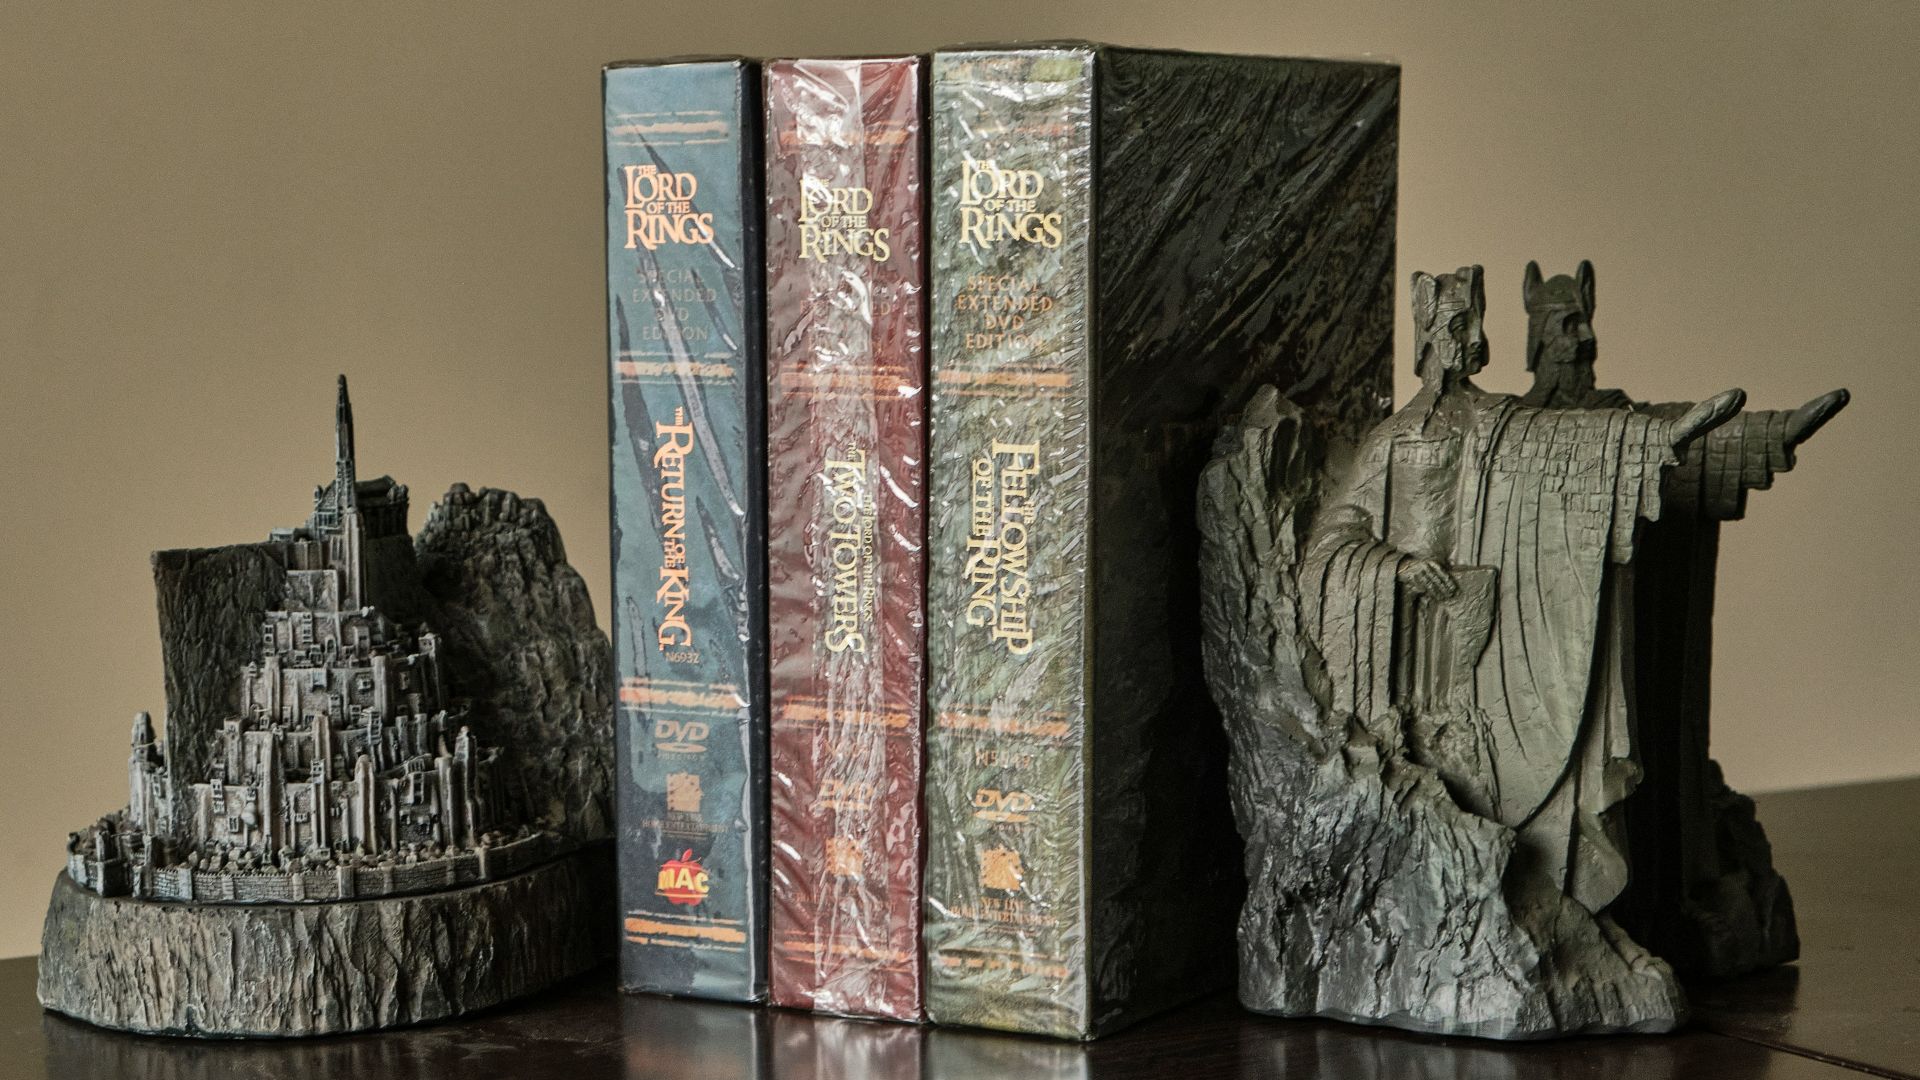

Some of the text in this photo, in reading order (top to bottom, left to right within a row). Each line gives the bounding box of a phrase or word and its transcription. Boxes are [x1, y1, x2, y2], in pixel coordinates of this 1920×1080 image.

[637, 165, 657, 175] THE
[960, 160, 1044, 206] LORD
[624, 165, 697, 209] LORD
[798, 178, 873, 222] LORD
[646, 202, 690, 214] OF THE
[983, 200, 1037, 213] OF THE
[624, 209, 714, 250] RINGS
[821, 216, 867, 228] OF THE
[959, 207, 1062, 249] RINGS
[798, 224, 890, 263] RINGS
[632, 288, 717, 303] EXNDED
[968, 273, 1041, 293] SPECIAL
[957, 295, 1053, 313] EXTENDED
[984, 312, 1024, 330] DVD
[965, 333, 1043, 350] EDITION
[675, 406, 684, 425] THE
[654, 421, 694, 540] RETURN
[974, 458, 994, 536] OF THE
[862, 516, 876, 543] LORD
[664, 539, 676, 568] THE
[992, 438, 1040, 655] FELLOWSHIP
[825, 524, 866, 653] TOWERS
[962, 534, 1001, 628] RING
[656, 566, 692, 648] KING
[665, 651, 700, 664] N6932
[655, 720, 710, 743] DVD
[975, 788, 1035, 812] DVD
